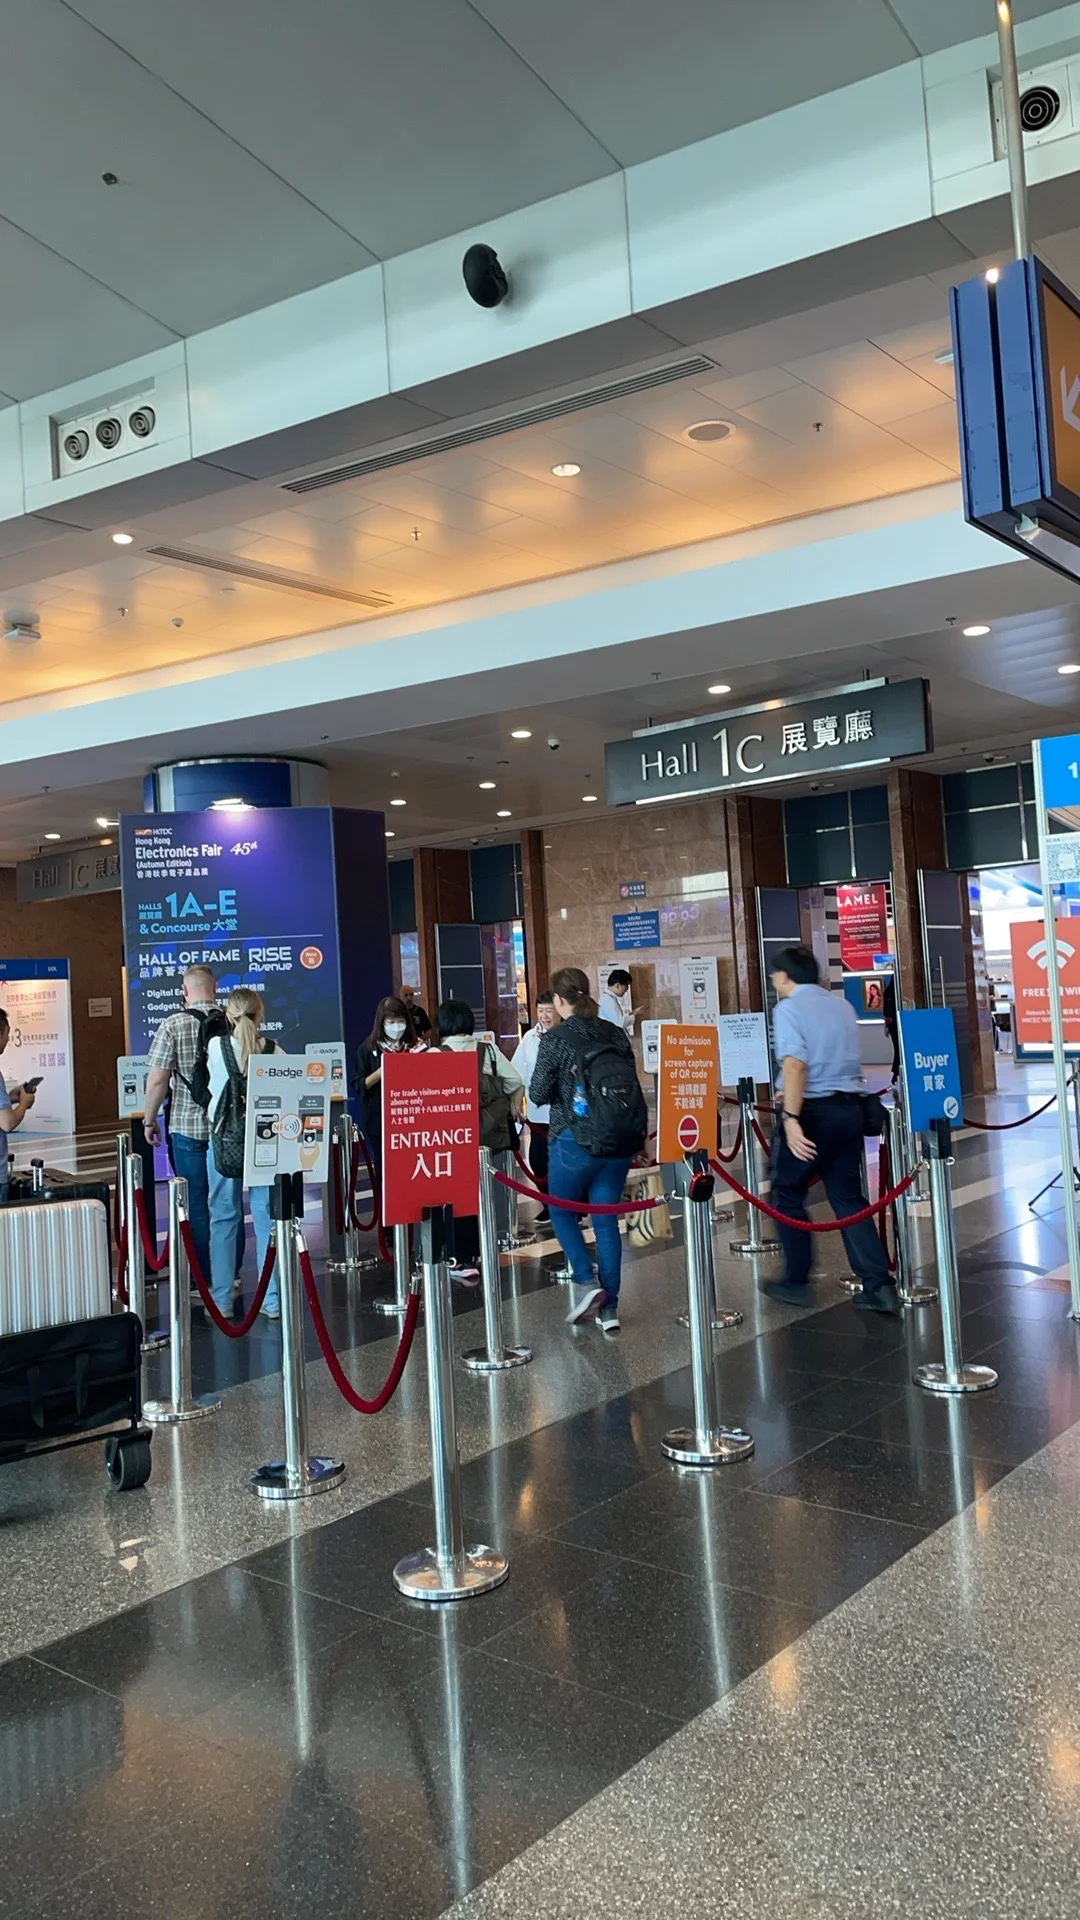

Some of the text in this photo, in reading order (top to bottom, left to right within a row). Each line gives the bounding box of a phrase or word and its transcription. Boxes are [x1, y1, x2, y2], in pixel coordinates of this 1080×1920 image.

[641, 742, 698, 780] Hall
[780, 709, 874, 755] 展覽廳
[135, 837, 171, 846] Hong Kong
[135, 845, 199, 859] Electronics
[201, 844, 223, 856] Fair
[136, 859, 192, 869] (Autumn Edition)
[33, 865, 60, 889] Hall
[138, 890, 237, 918] HALLS 1A-E
[837, 894, 878, 908] LAMEL
[139, 918, 238, 934] & Concourse 大堂
[138, 949, 240, 966] HALL OF FAME
[248, 946, 292, 962] RISE
[248, 962, 292, 972] Avenue
[147, 989, 173, 999] Digital
[1022, 988, 1045, 997] FREE
[14, 1028, 22, 1047] 3
[666, 1035, 711, 1046] No admission
[684, 1046, 694, 1056] for
[664, 1059, 713, 1071] screen capture
[914, 1052, 949, 1072] Buyer
[256, 1067, 303, 1079] e-Badge
[670, 1069, 707, 1079] of QR code
[923, 1074, 945, 1092] 買家
[402, 1088, 418, 1097] trade
[419, 1088, 440, 1096] visitors
[441, 1087, 455, 1097] aged
[390, 1097, 423, 1106] above only
[273, 1123, 290, 1132] NFC
[391, 1128, 472, 1150] ENTRANCE
[411, 1151, 452, 1180] 入口
